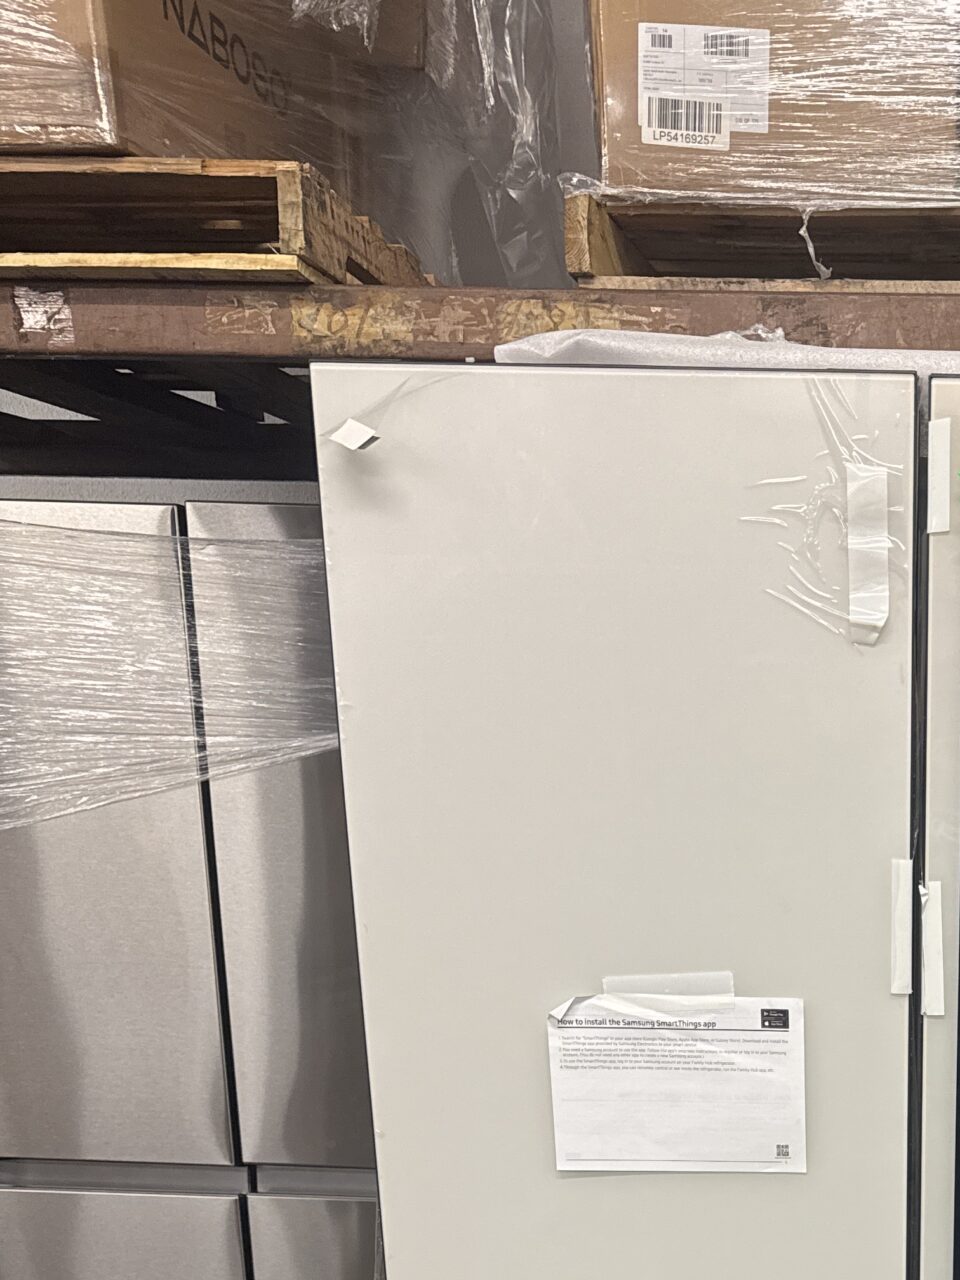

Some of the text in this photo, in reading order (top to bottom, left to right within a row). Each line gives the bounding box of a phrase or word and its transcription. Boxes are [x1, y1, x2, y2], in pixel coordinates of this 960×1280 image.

[653, 130, 716, 145] LP54169257
[585, 1018, 607, 1026] install
[621, 1019, 656, 1028] Samsung
[702, 1020, 717, 1028] app
